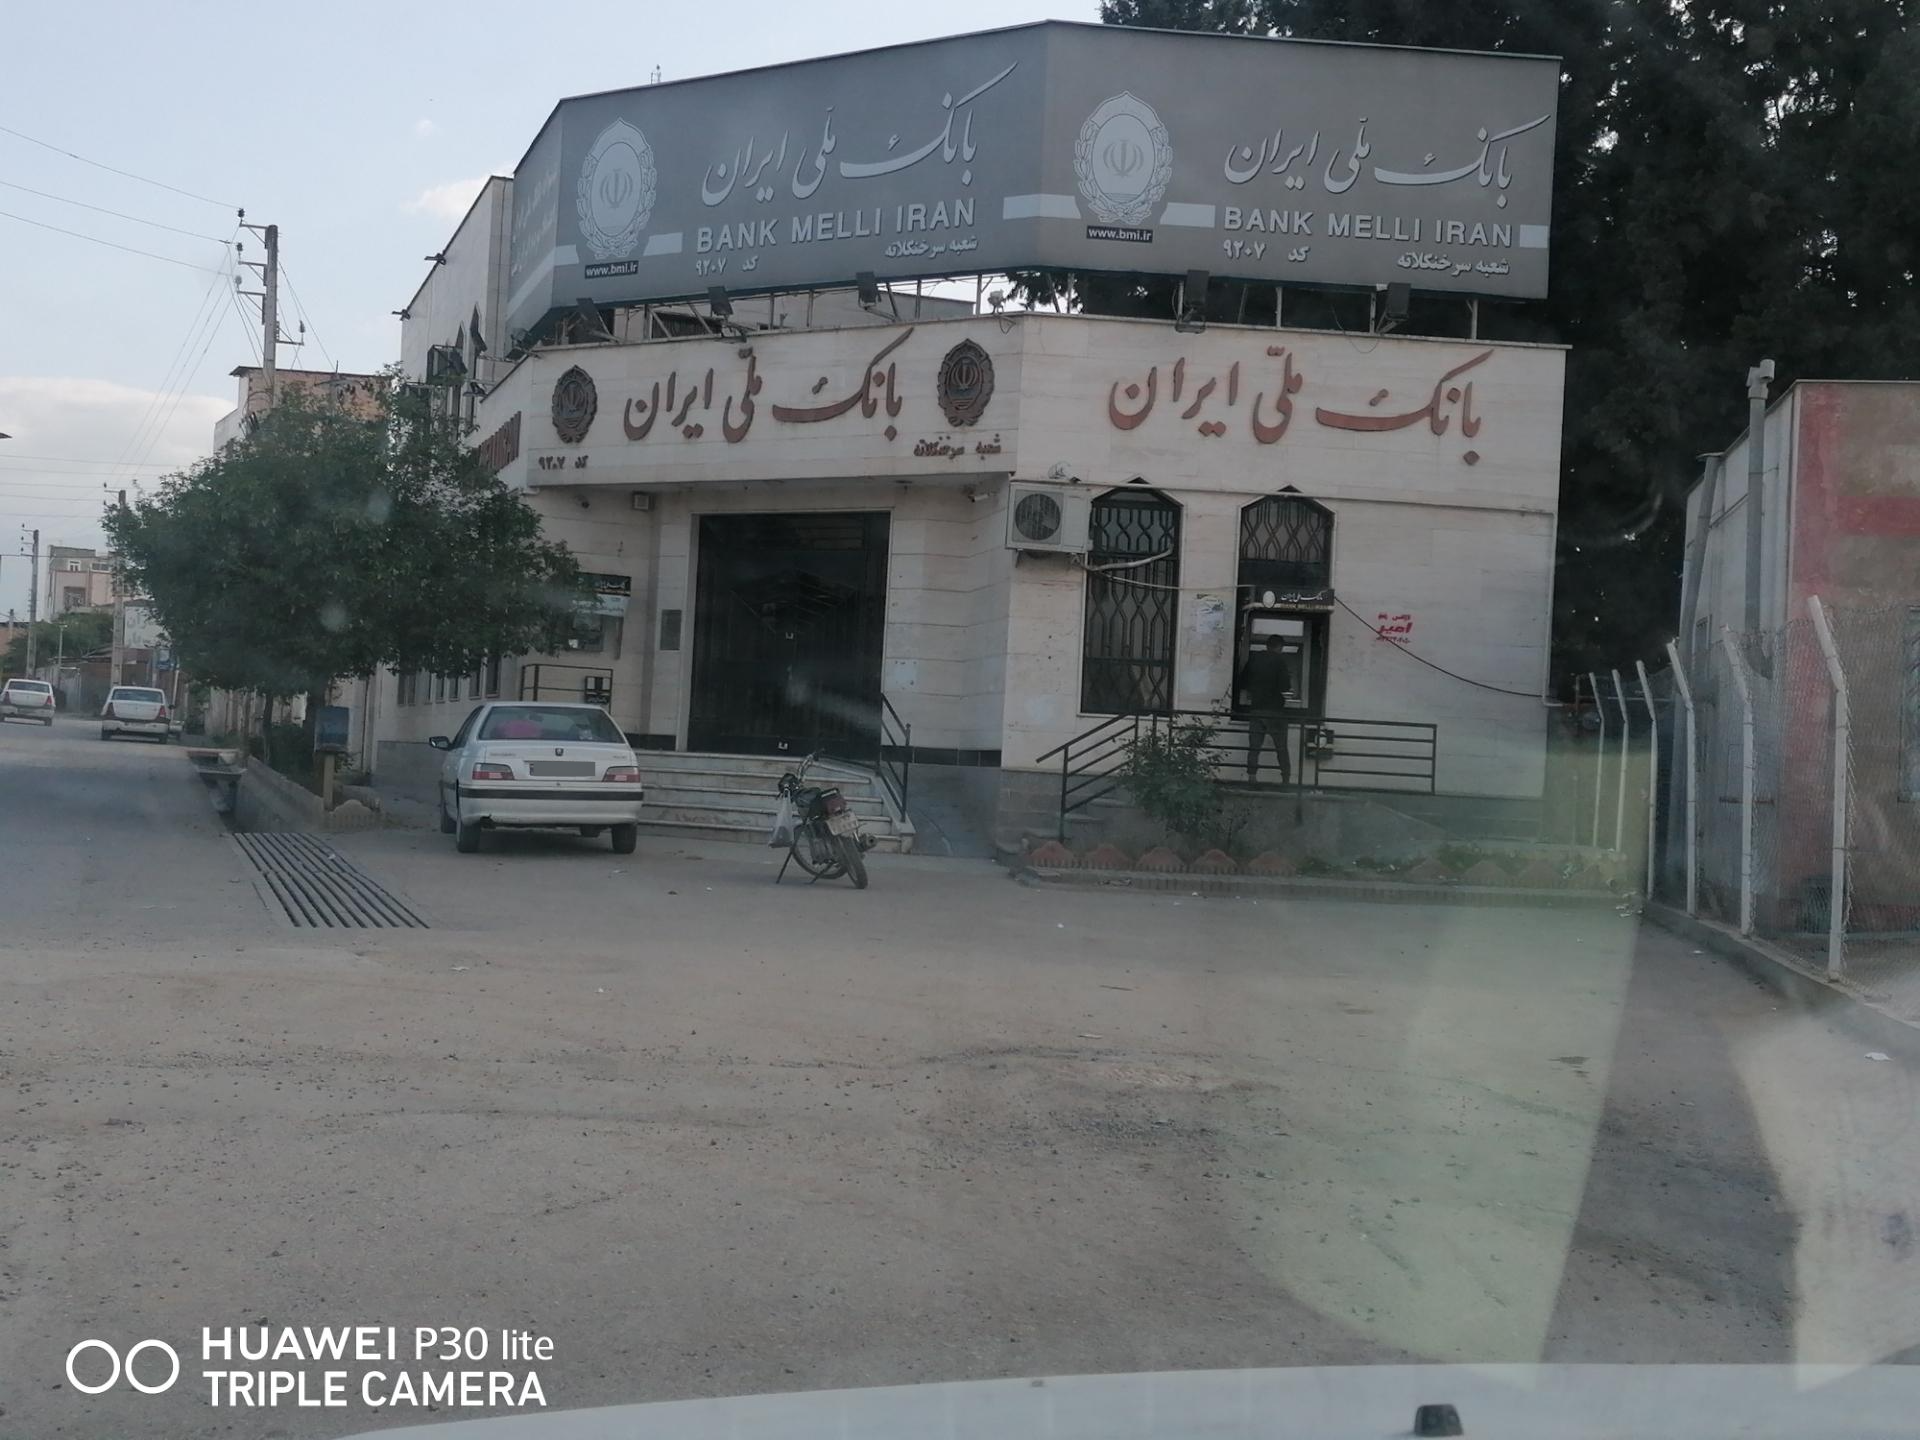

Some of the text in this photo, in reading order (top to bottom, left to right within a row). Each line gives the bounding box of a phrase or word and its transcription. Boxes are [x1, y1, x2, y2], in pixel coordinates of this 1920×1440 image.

[839, 60, 1018, 186] بانک
[701, 128, 789, 207] ایران
[1224, 128, 1320, 190] ایران
[1374, 113, 1551, 209] بانک
[696, 197, 976, 254] BANK MELLI IRAN
[949, 235, 979, 255] شعبه
[1088, 227, 1152, 242] www.bmi.ir
[1223, 206, 1512, 247] BANK MELLI IRAN
[1223, 239, 1311, 262] کد ۹۲۰۷
[585, 262, 638, 278] www.bmi.ir
[742, 255, 760, 272] کد
[1475, 257, 1510, 277] شعبه
[623, 366, 714, 441] ایران
[772, 327, 915, 442] بانک
[1108, 356, 1240, 438] ایران
[1315, 349, 1495, 466] بانک
